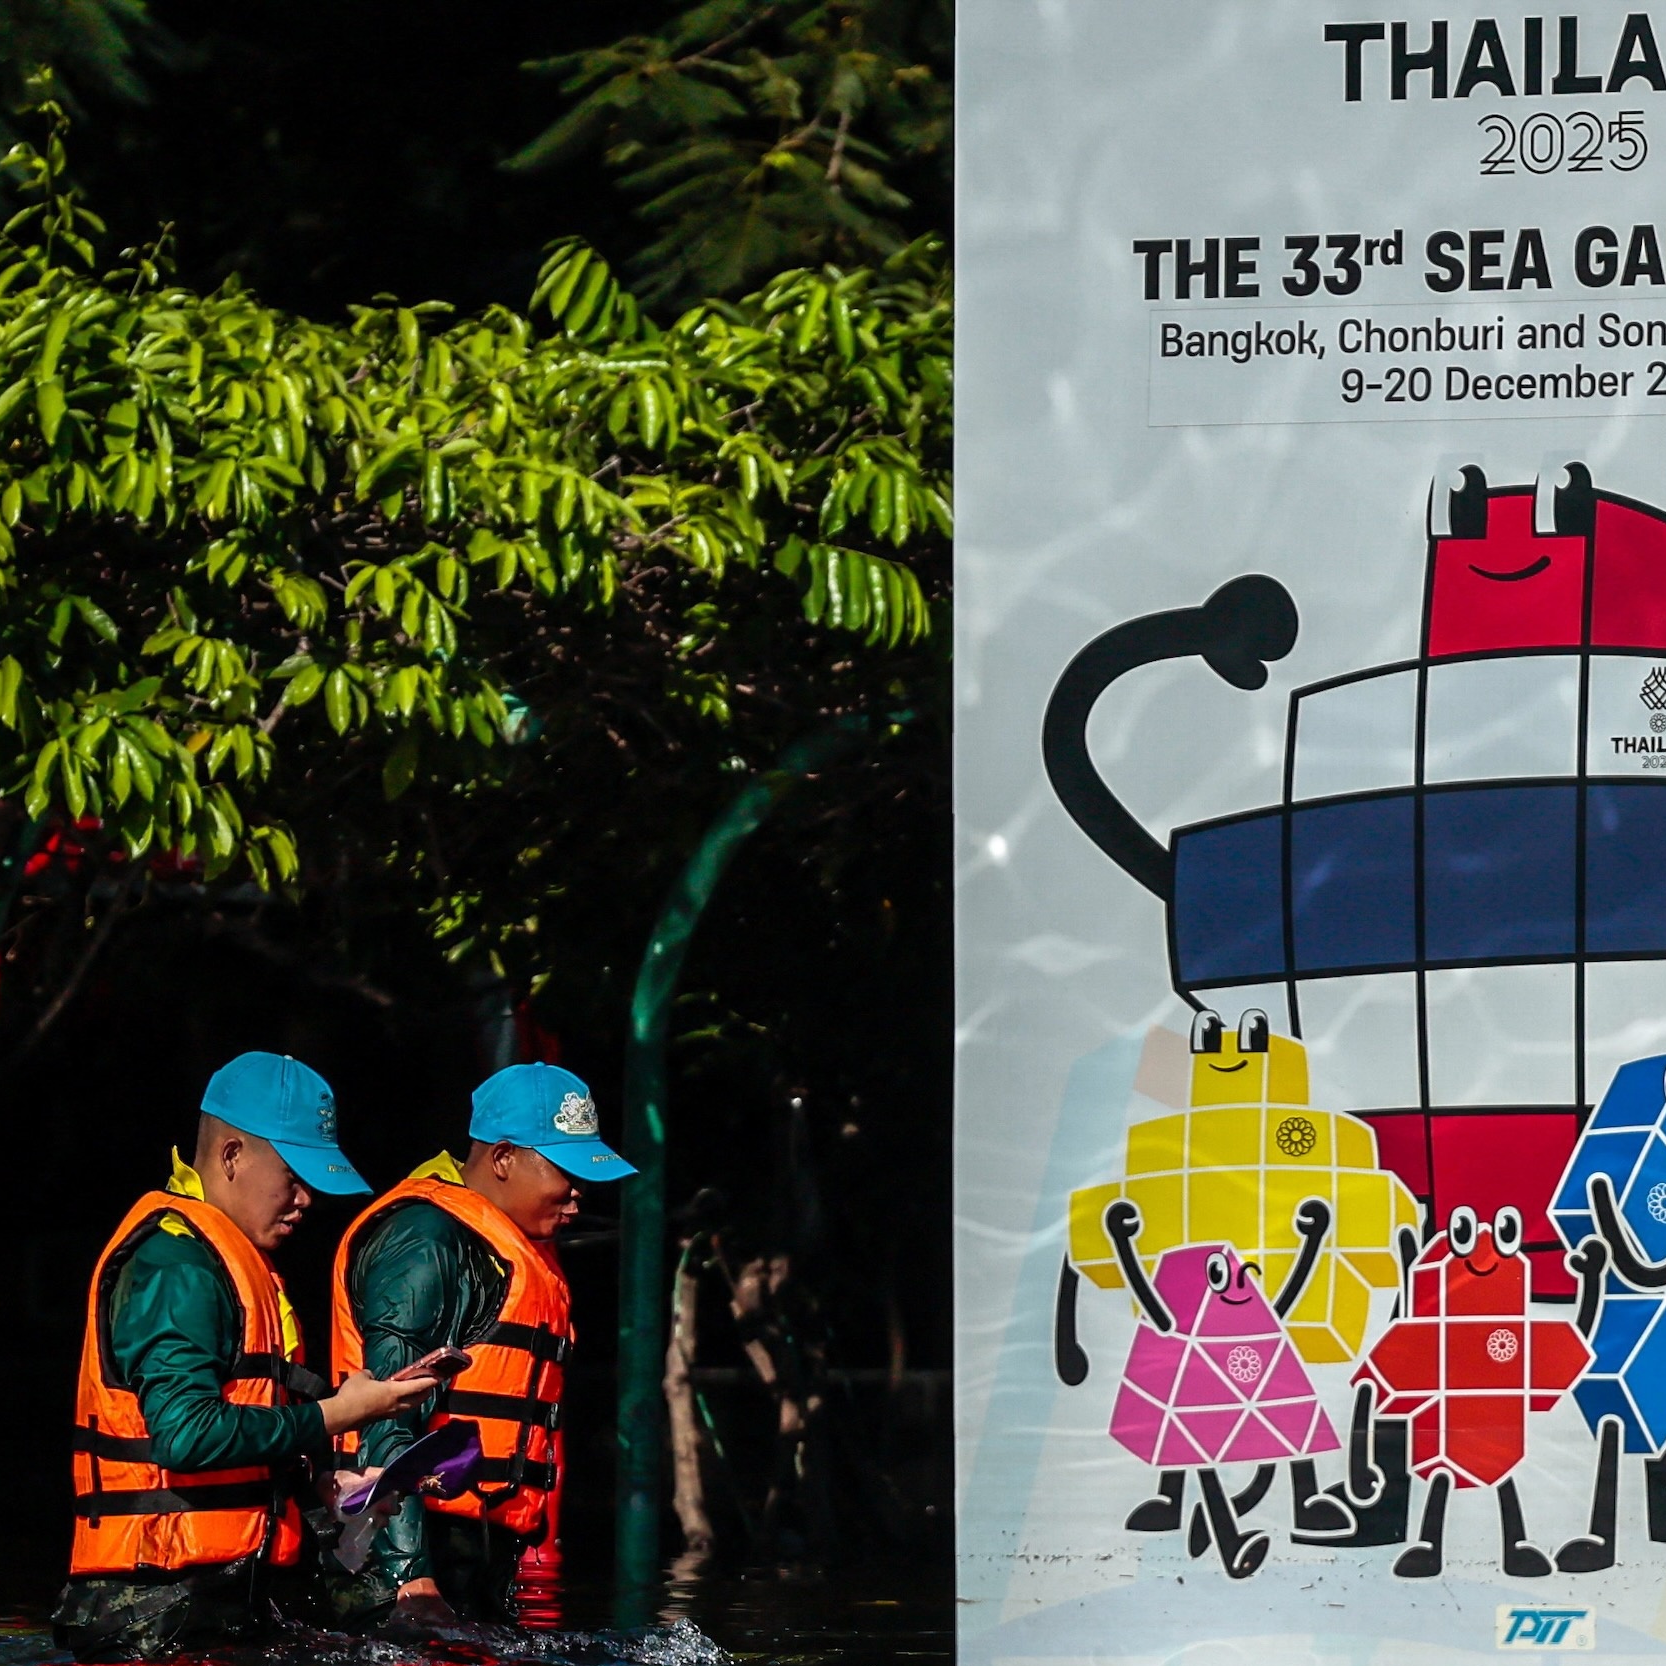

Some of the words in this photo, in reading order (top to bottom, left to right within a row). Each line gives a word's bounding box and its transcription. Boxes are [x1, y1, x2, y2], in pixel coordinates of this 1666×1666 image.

[1477, 111, 1648, 176] 2025
[1132, 237, 1260, 301] THE
[1282, 230, 1403, 297] 33rd
[1424, 229, 1553, 293] SEA
[1161, 320, 1325, 364] Bangkok,
[1338, 317, 1503, 354] Chonburi
[1517, 313, 1585, 350] and
[1341, 367, 1432, 404] 9-20
[1445, 363, 1635, 401] December
[1502, 1608, 1588, 1645] PTT
